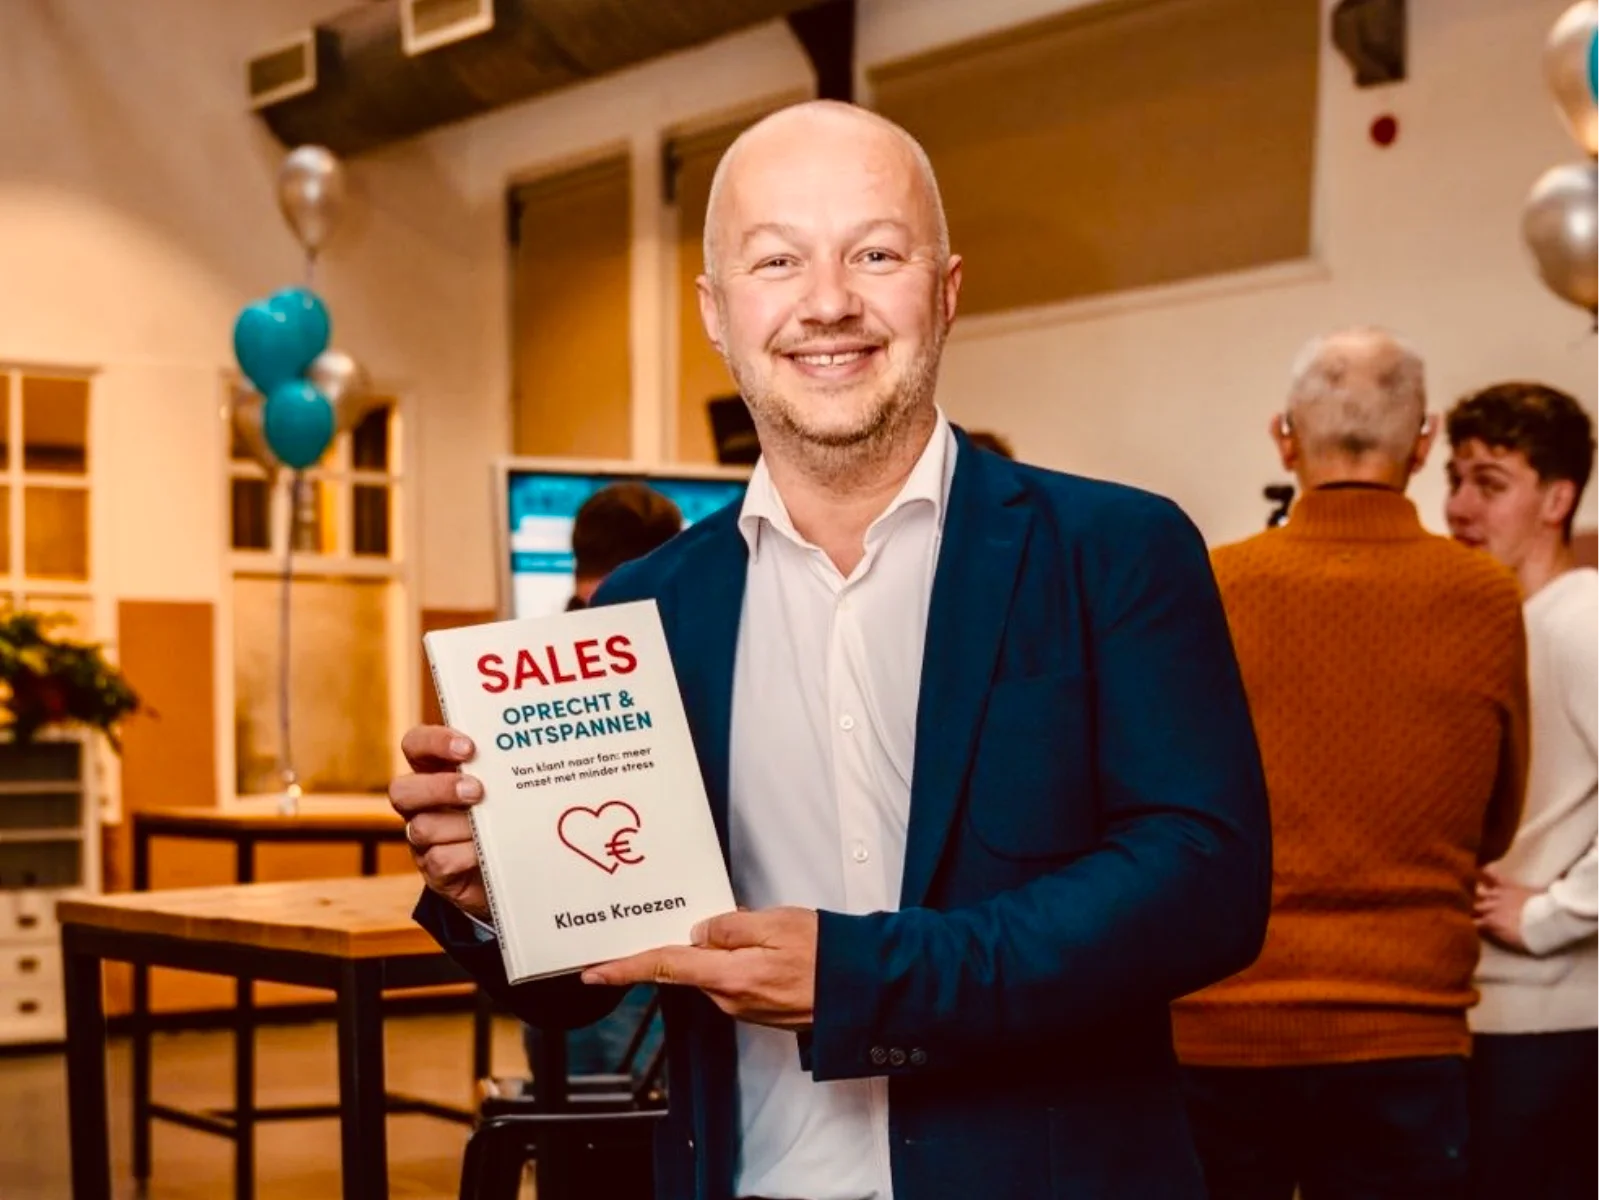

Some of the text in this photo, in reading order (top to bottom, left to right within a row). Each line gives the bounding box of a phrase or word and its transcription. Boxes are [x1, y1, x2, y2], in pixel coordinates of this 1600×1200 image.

[477, 635, 637, 693] SALES
[503, 690, 634, 725] OPRECHT &
[496, 711, 652, 751] ONTSPANNEN
[511, 747, 651, 776] Van klant naar fan: meer
[516, 760, 654, 789] omzet met minder stress
[554, 896, 686, 929] Klaas Kroezen
